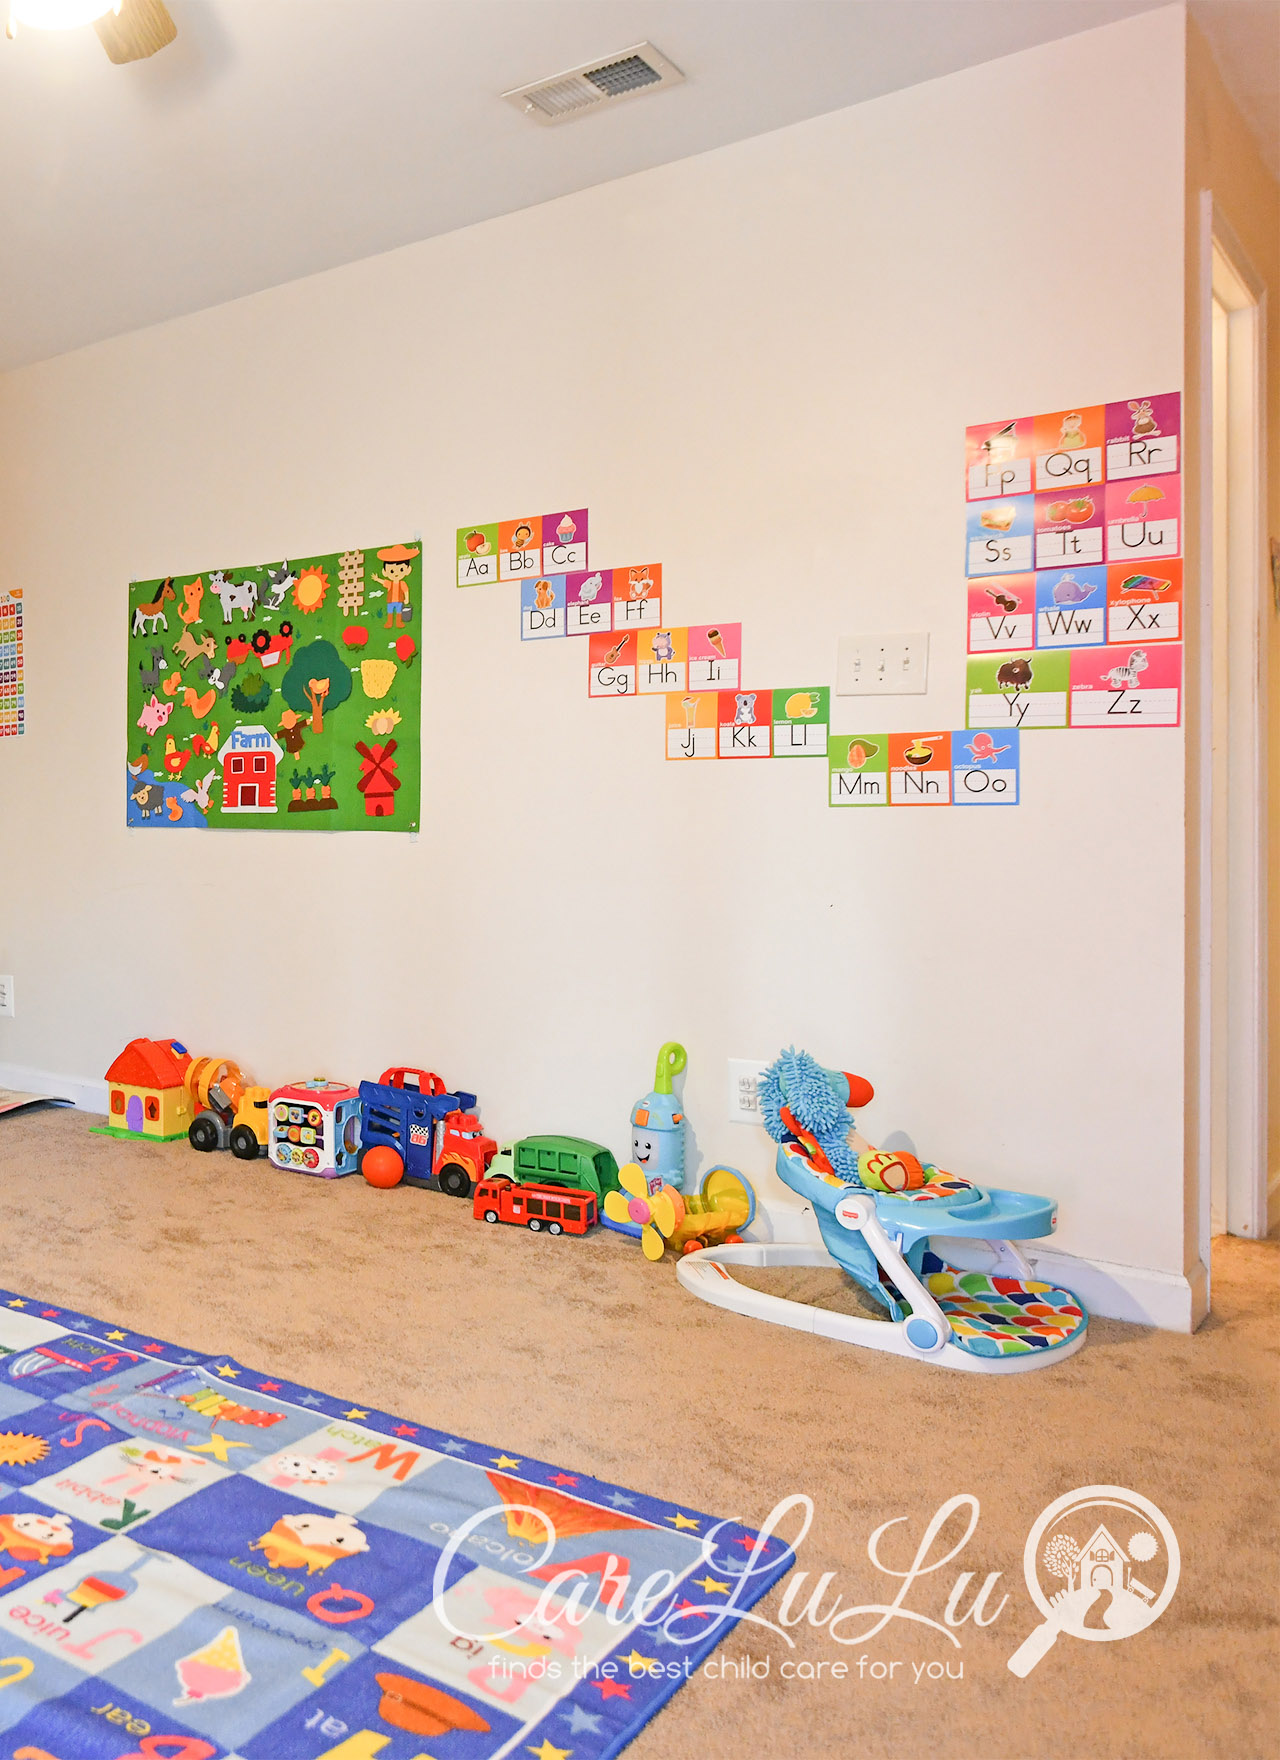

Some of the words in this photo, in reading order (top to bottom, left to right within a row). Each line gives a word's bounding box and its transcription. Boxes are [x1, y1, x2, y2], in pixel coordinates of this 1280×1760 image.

[1129, 440, 1163, 467] Rr
[1045, 452, 1093, 483] Qq
[1055, 530, 1083, 555] Tt
[1121, 521, 1163, 548] Uu
[509, 551, 534, 571] Bb
[551, 545, 577, 566] Cc
[985, 539, 1012, 563] Ss
[465, 557, 489, 577] Aa
[529, 608, 556, 630] Dd
[579, 604, 601, 625] Ee
[625, 598, 648, 621] Ff
[1126, 603, 1161, 631] Xx
[986, 615, 1017, 640] Vv
[1046, 610, 1093, 636] Ww
[597, 666, 628, 694] Gg
[648, 663, 677, 684] Hh
[706, 659, 721, 681] Ii
[1003, 692, 1030, 727] Yy
[1107, 689, 1142, 715] Zz
[230, 730, 272, 750] Farm
[681, 728, 695, 758] Jj
[732, 726, 757, 748] Kk
[839, 773, 880, 795] Mm
[905, 771, 939, 794] Nn
[964, 770, 1007, 793] Oo
